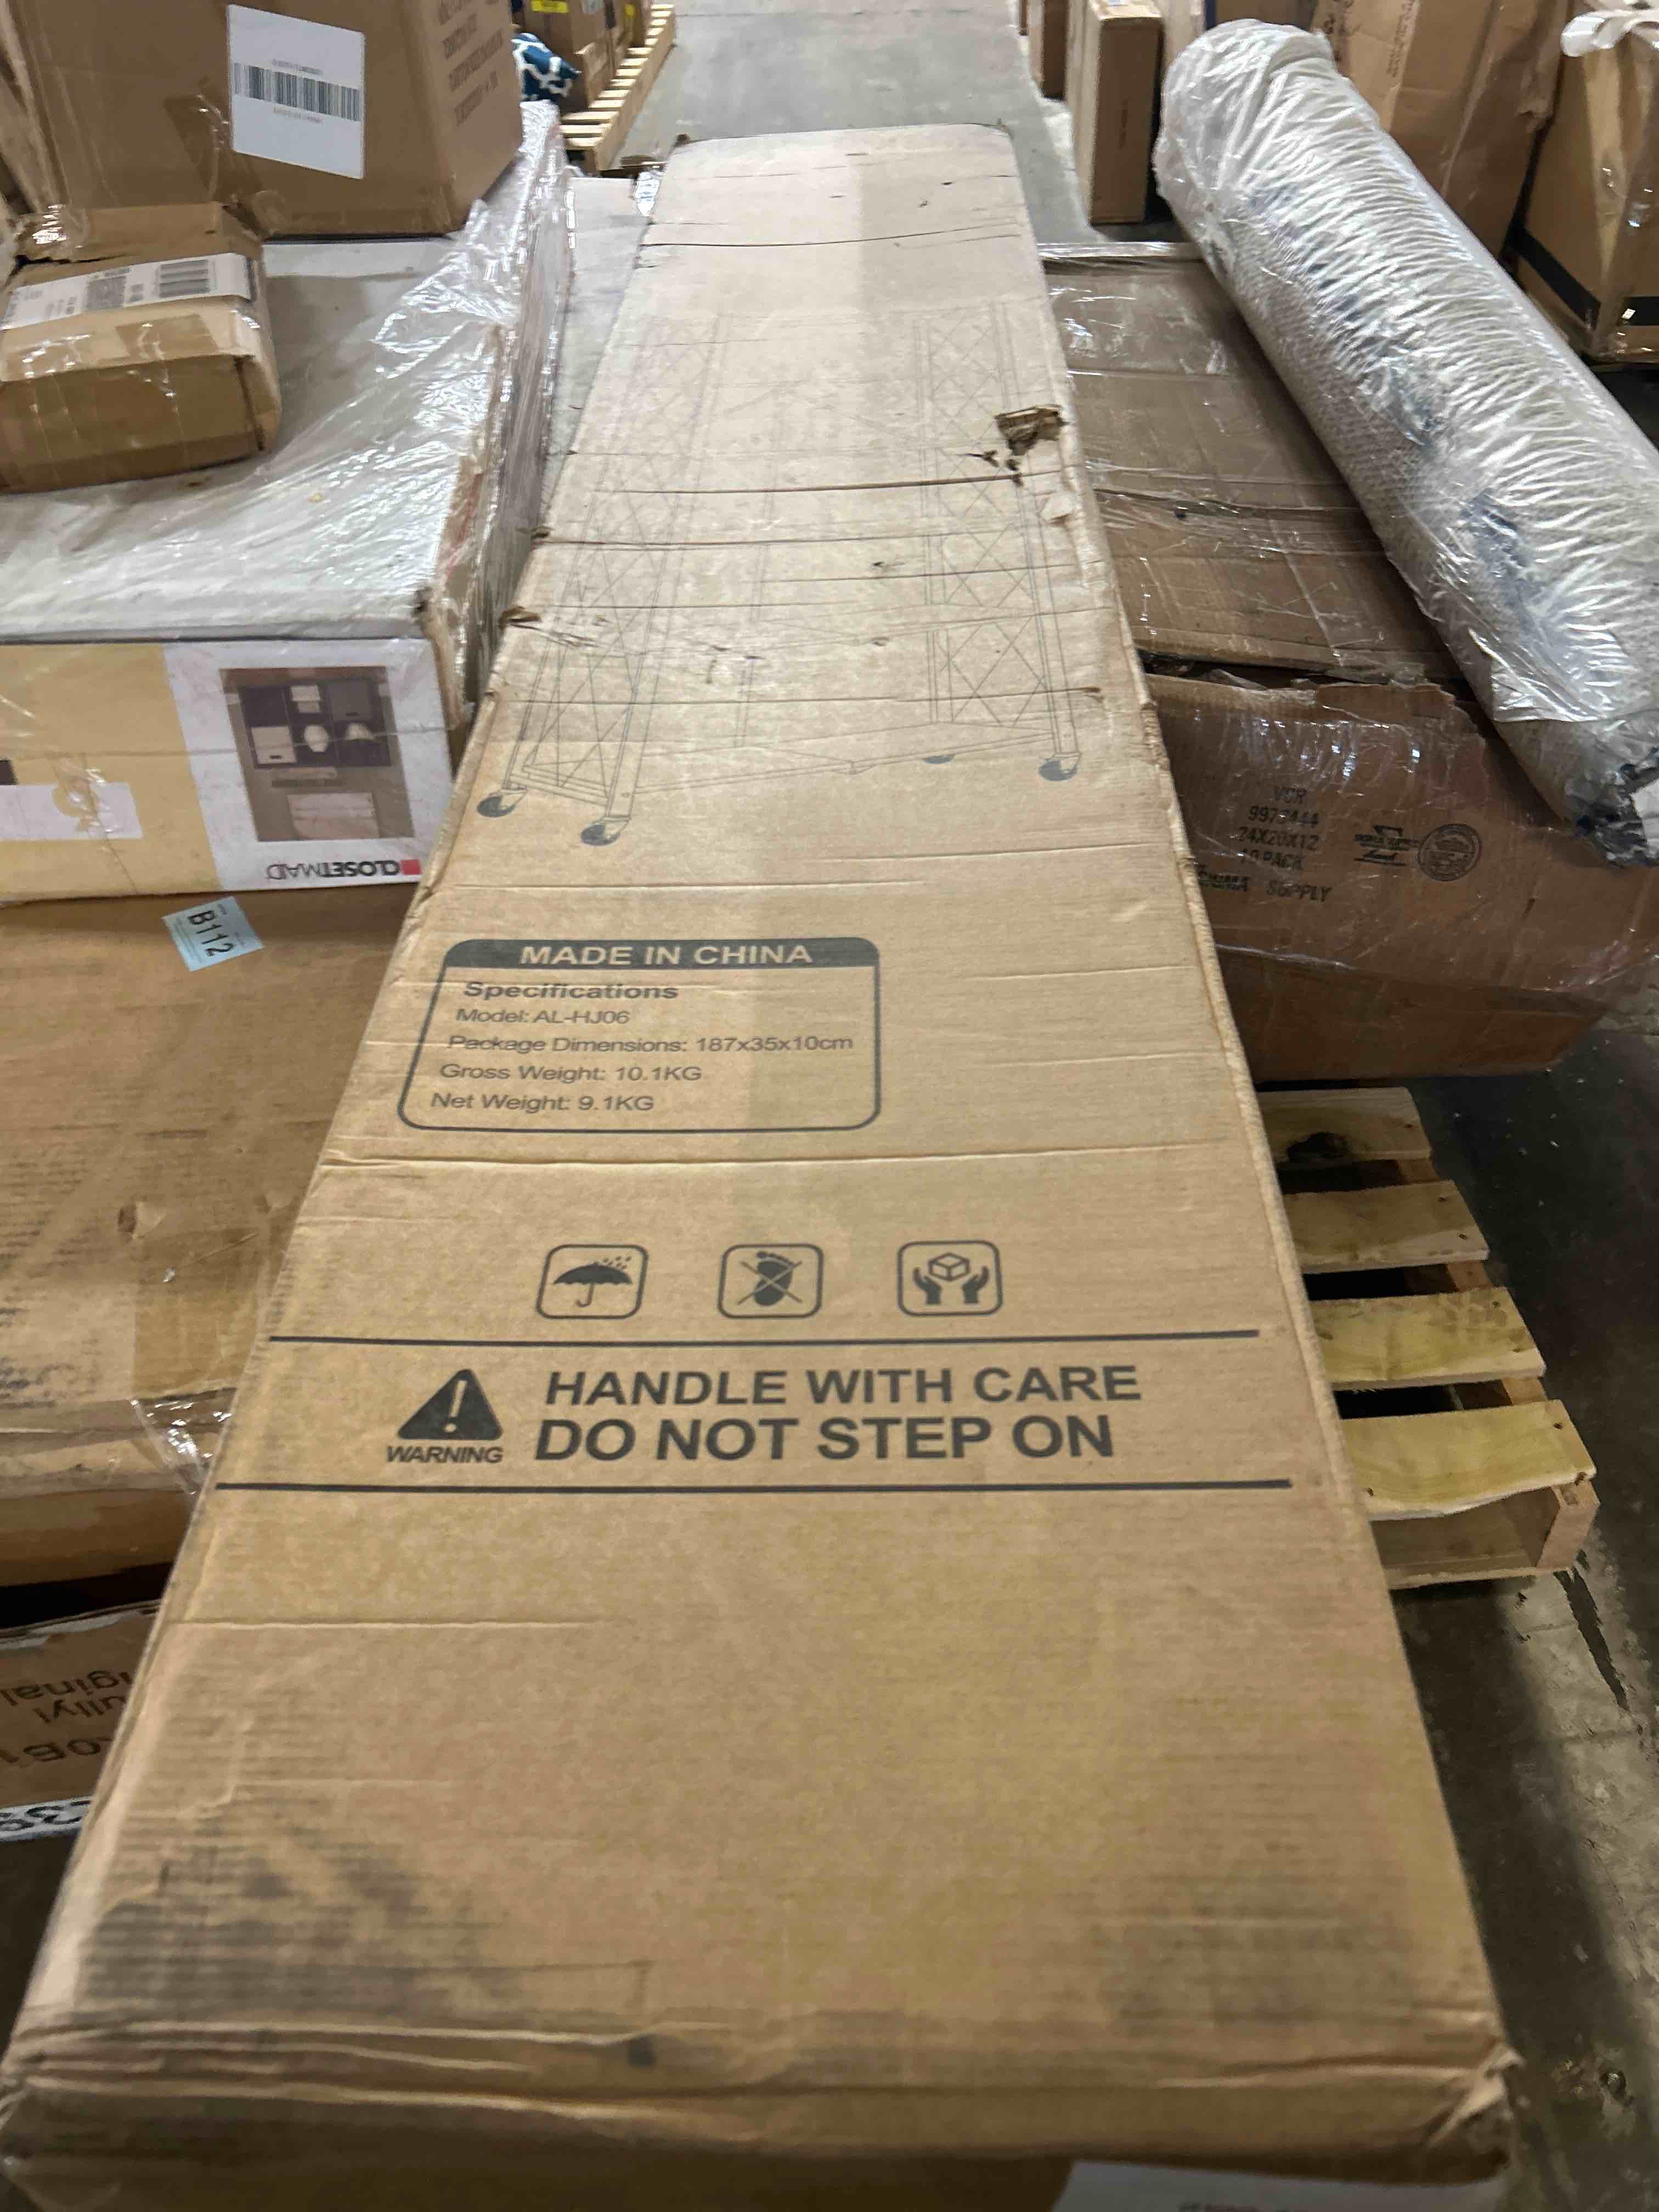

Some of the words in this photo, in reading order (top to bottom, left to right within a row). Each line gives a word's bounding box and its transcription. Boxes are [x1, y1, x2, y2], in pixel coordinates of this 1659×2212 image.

[266, 860, 400, 881] CLOSETMAID
[187, 910, 236, 957] B112
[520, 945, 631, 966] MADE
[644, 945, 681, 966] IN
[693, 944, 813, 965] CHINA
[462, 981, 679, 1001] Specifications
[455, 1008, 530, 1024] Model:
[533, 1009, 630, 1025] AL-HJ06
[446, 1035, 546, 1054] Package
[551, 1037, 688, 1052] Dimensions:
[696, 1035, 854, 1053] 187x35x10cm
[438, 1063, 511, 1080] Gross
[517, 1065, 607, 1084] Weight:
[615, 1065, 703, 1082] 10.1KG
[430, 1092, 475, 1109] Net
[481, 1093, 571, 1115] Weight:
[577, 1094, 654, 1111] 9.1KG
[544, 1369, 788, 1406] HANDLE
[805, 1368, 953, 1404] WITH
[973, 1364, 1142, 1403] CARE
[534, 1418, 636, 1462] DO
[655, 1417, 799, 1462] NOT
[816, 1415, 992, 1460] STEP
[1012, 1414, 1114, 1459] ON
[385, 1444, 504, 1464] WARNING
[0, 1670, 132, 1707] iginal
